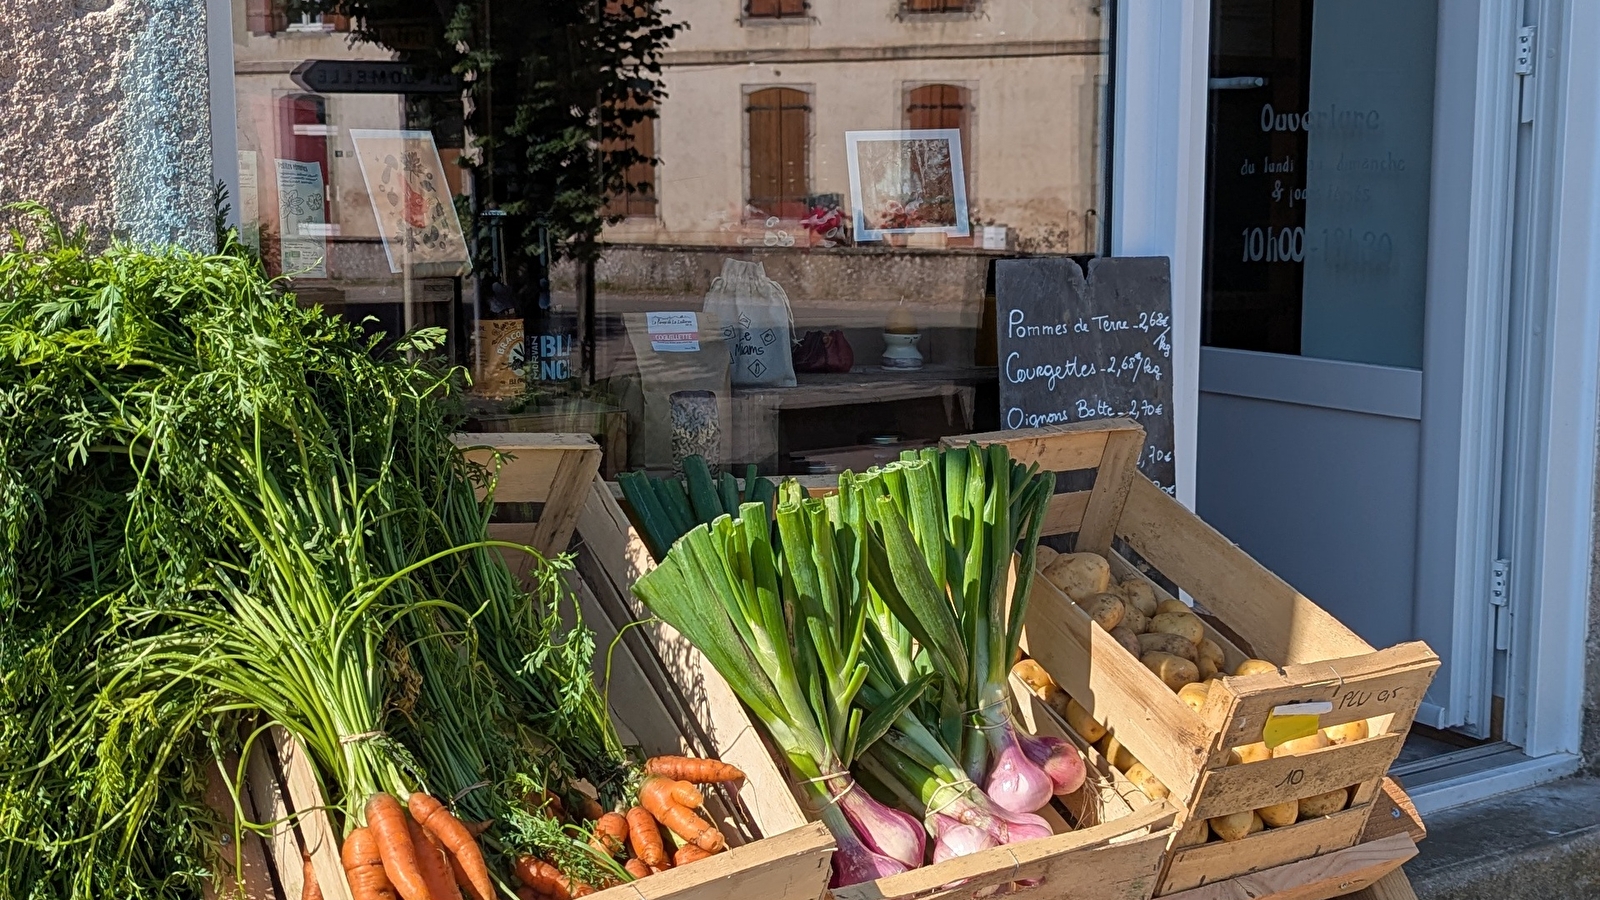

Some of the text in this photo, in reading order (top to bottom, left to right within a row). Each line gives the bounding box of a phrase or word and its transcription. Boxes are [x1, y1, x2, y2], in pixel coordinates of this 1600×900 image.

[1240, 158, 1255, 175] du
[1264, 156, 1294, 173] lundi
[1008, 309, 1067, 338] Pommes
[1074, 318, 1089, 333] de
[1091, 315, 1129, 332] Terre
[497, 330, 524, 355] BRACO
[531, 335, 539, 380] MORVAN
[1006, 352, 1096, 391] Courgettes
[1007, 407, 1068, 429] Oignons
[1076, 399, 1115, 418] Botte
[1338, 690, 1371, 709] PLU
